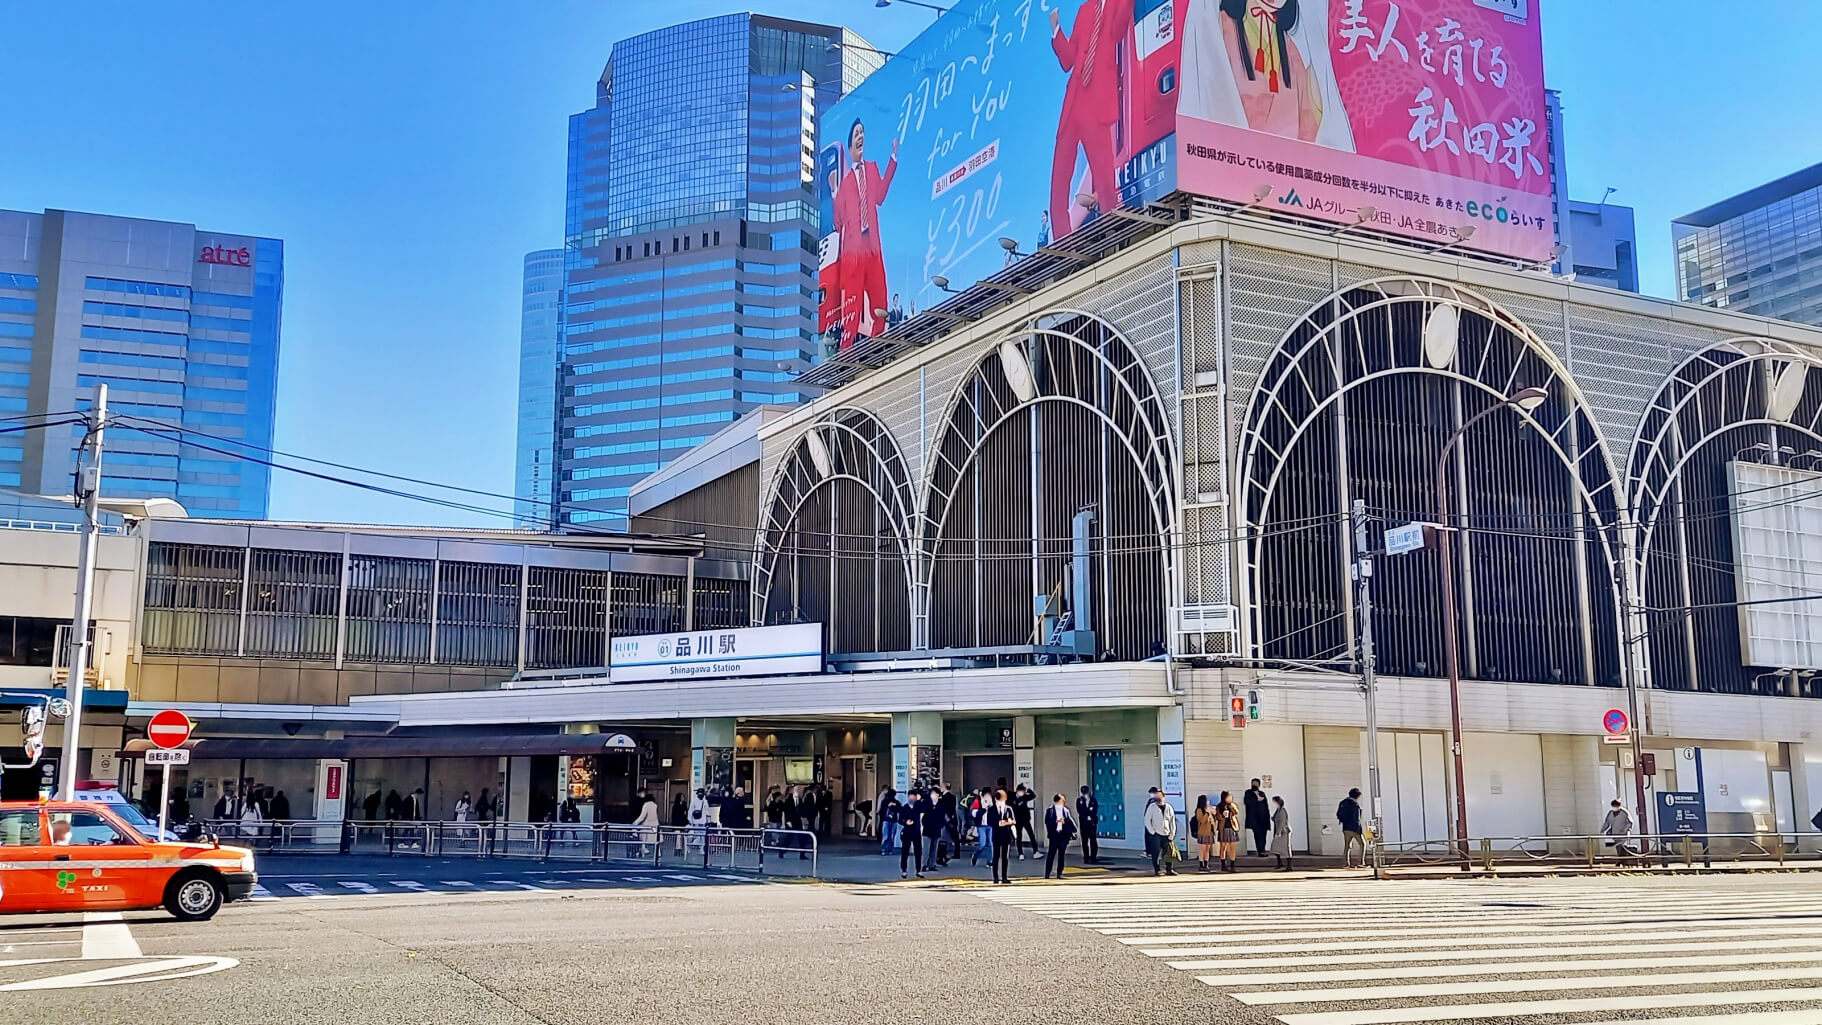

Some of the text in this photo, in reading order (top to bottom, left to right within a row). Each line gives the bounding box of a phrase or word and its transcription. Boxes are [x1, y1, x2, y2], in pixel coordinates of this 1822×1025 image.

[927, 80, 1012, 180] for You
[1408, 86, 1544, 180] 秋田米
[1115, 141, 1167, 189] KEIKYU
[200, 243, 251, 266] atré
[660, 645, 669, 654] 01
[675, 634, 736, 657] 品川駅
[670, 663, 741, 676] Shinagawa Station
